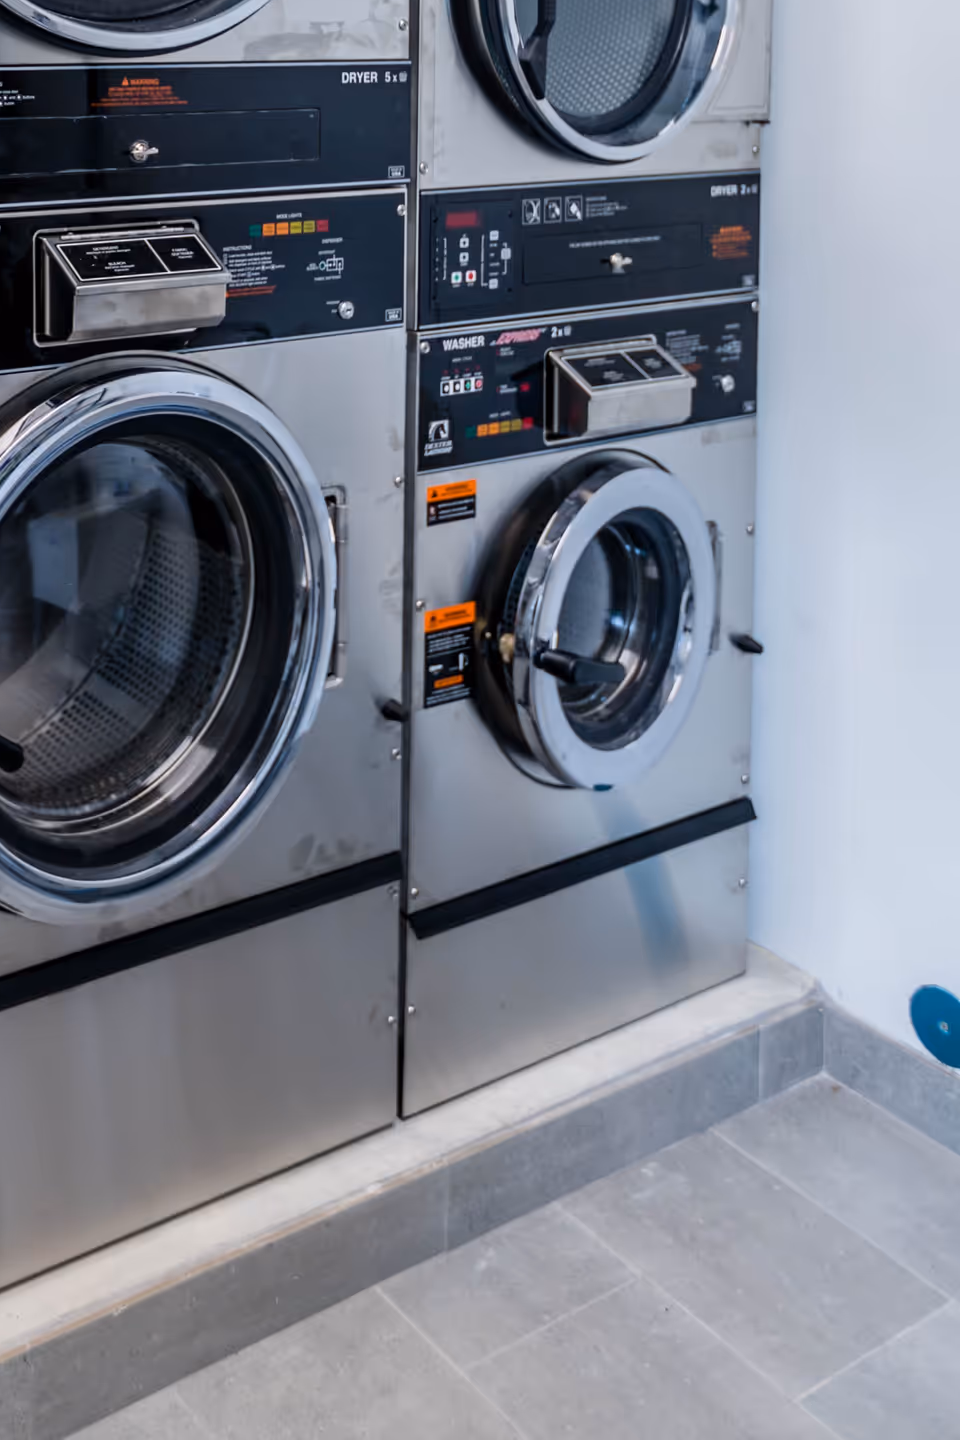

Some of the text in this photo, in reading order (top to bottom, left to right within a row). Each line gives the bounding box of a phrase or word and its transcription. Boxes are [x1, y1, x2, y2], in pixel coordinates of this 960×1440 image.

[341, 71, 378, 84] DRYER
[711, 184, 737, 197] DRYER
[443, 335, 485, 351] WASHER
